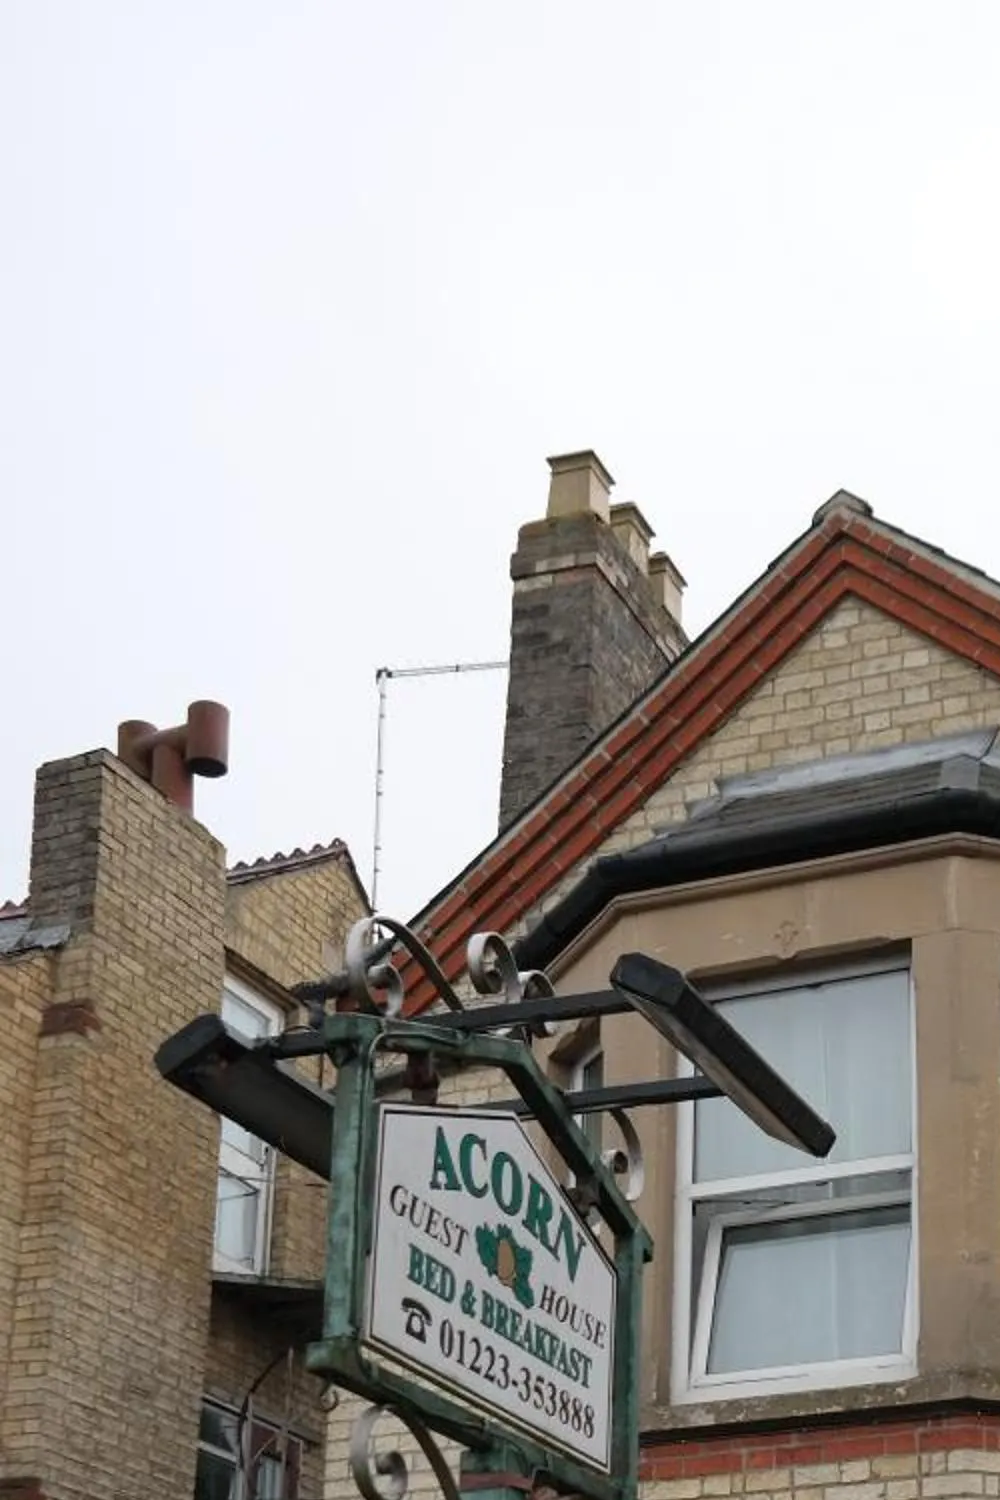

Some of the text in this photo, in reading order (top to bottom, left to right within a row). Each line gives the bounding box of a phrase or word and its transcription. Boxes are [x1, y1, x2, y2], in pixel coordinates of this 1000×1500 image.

[390, 1184, 607, 1350] GUEST HOUSE
[429, 1125, 587, 1283] ACORN
[407, 1243, 593, 1389] BED & BREAKFAST
[439, 1318, 595, 1440] 01223-353888
